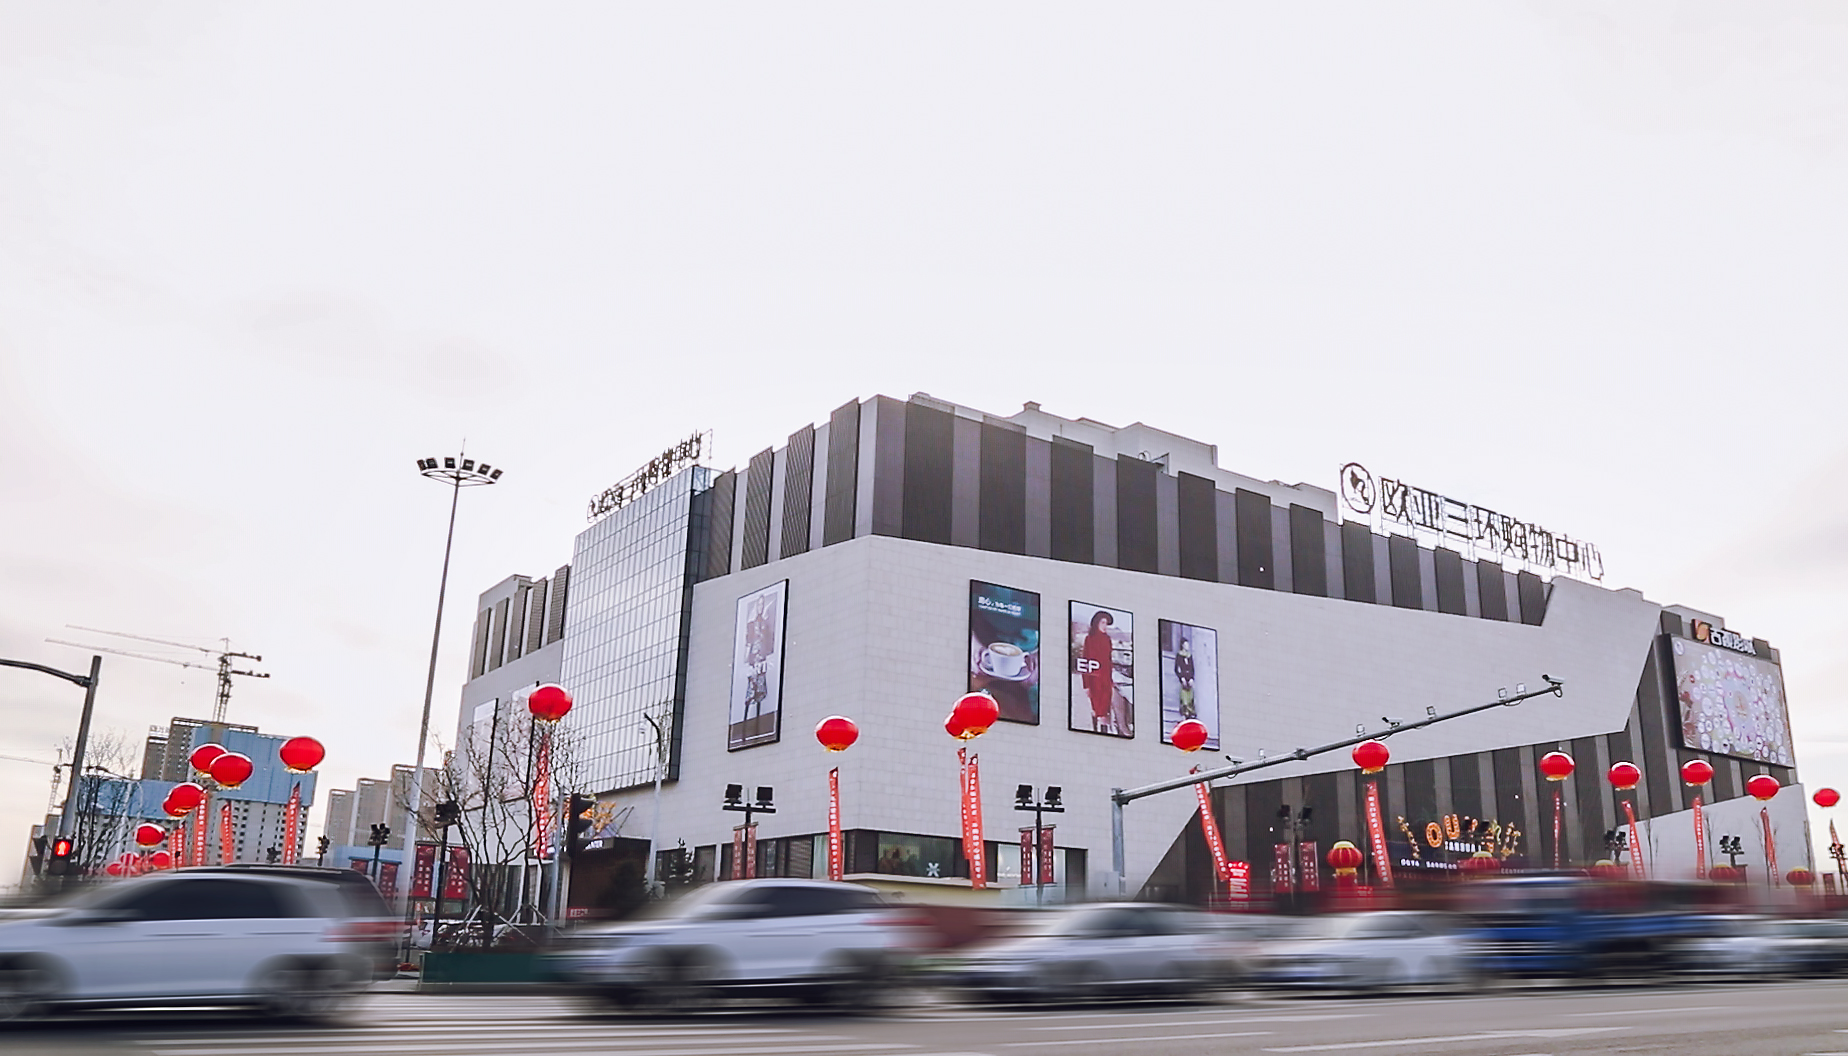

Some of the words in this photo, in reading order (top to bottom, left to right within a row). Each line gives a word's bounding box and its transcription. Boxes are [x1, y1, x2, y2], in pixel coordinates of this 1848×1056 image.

[1380, 477, 1605, 581] 欧亚三环购物中心
[1076, 657, 1100, 673] EP
